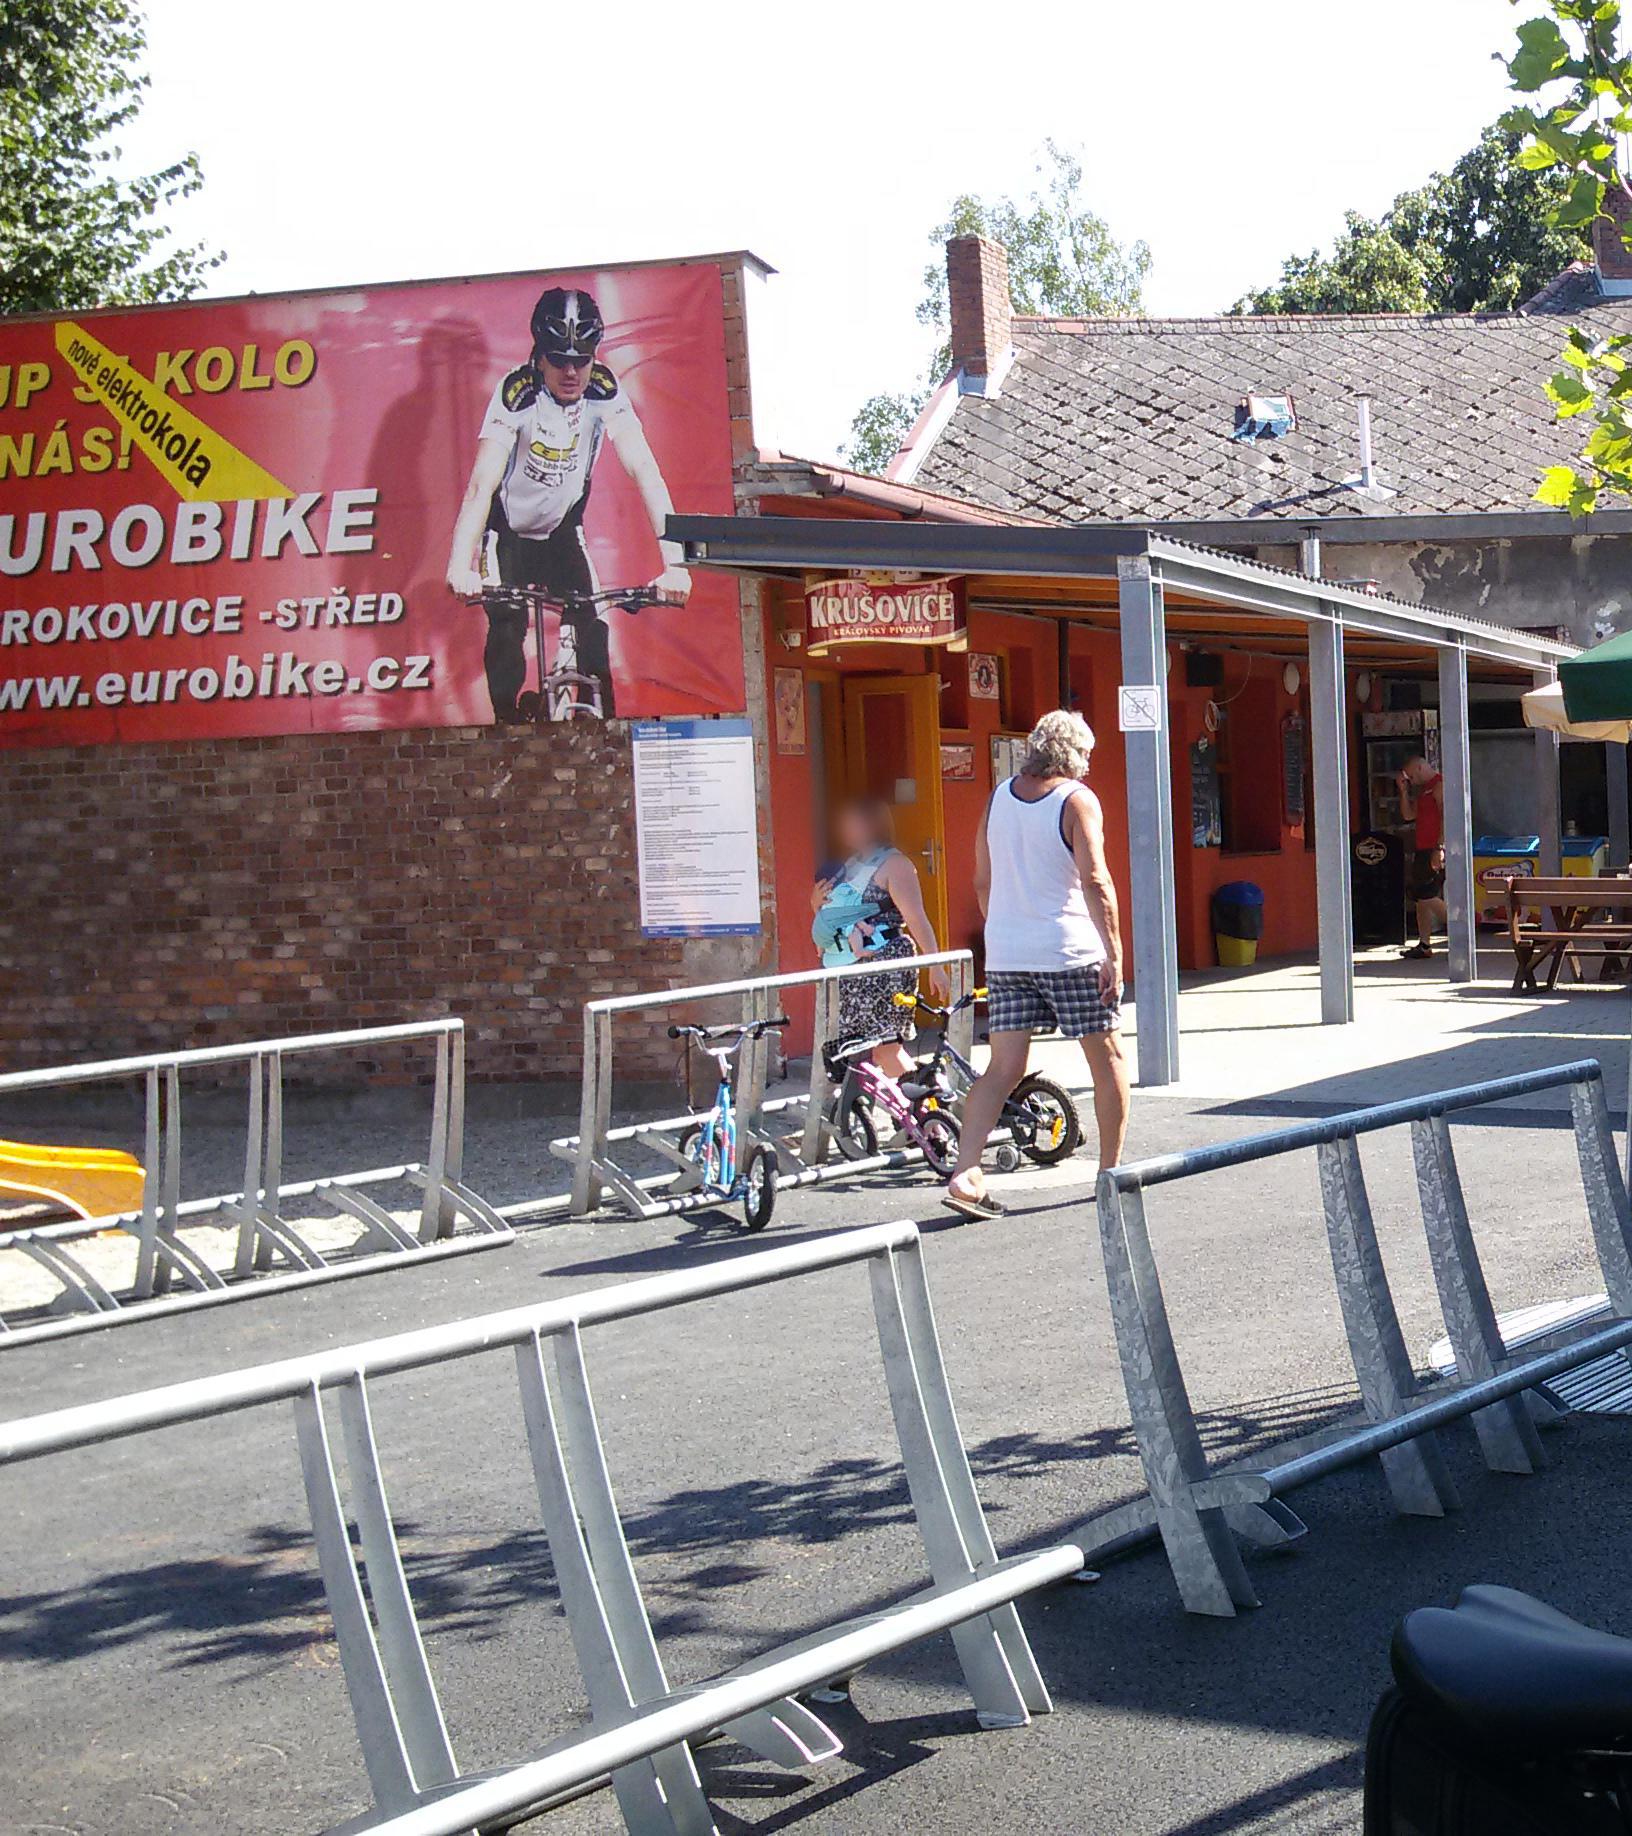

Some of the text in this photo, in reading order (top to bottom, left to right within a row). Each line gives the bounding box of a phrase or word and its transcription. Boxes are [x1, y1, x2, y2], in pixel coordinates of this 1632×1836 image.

[154, 340, 316, 396] KOLO
[67, 338, 99, 376] nové
[96, 366, 212, 488] elektrokola
[0, 596, 244, 646] ROKOVICE
[810, 590, 954, 628] KRUŠOVICE
